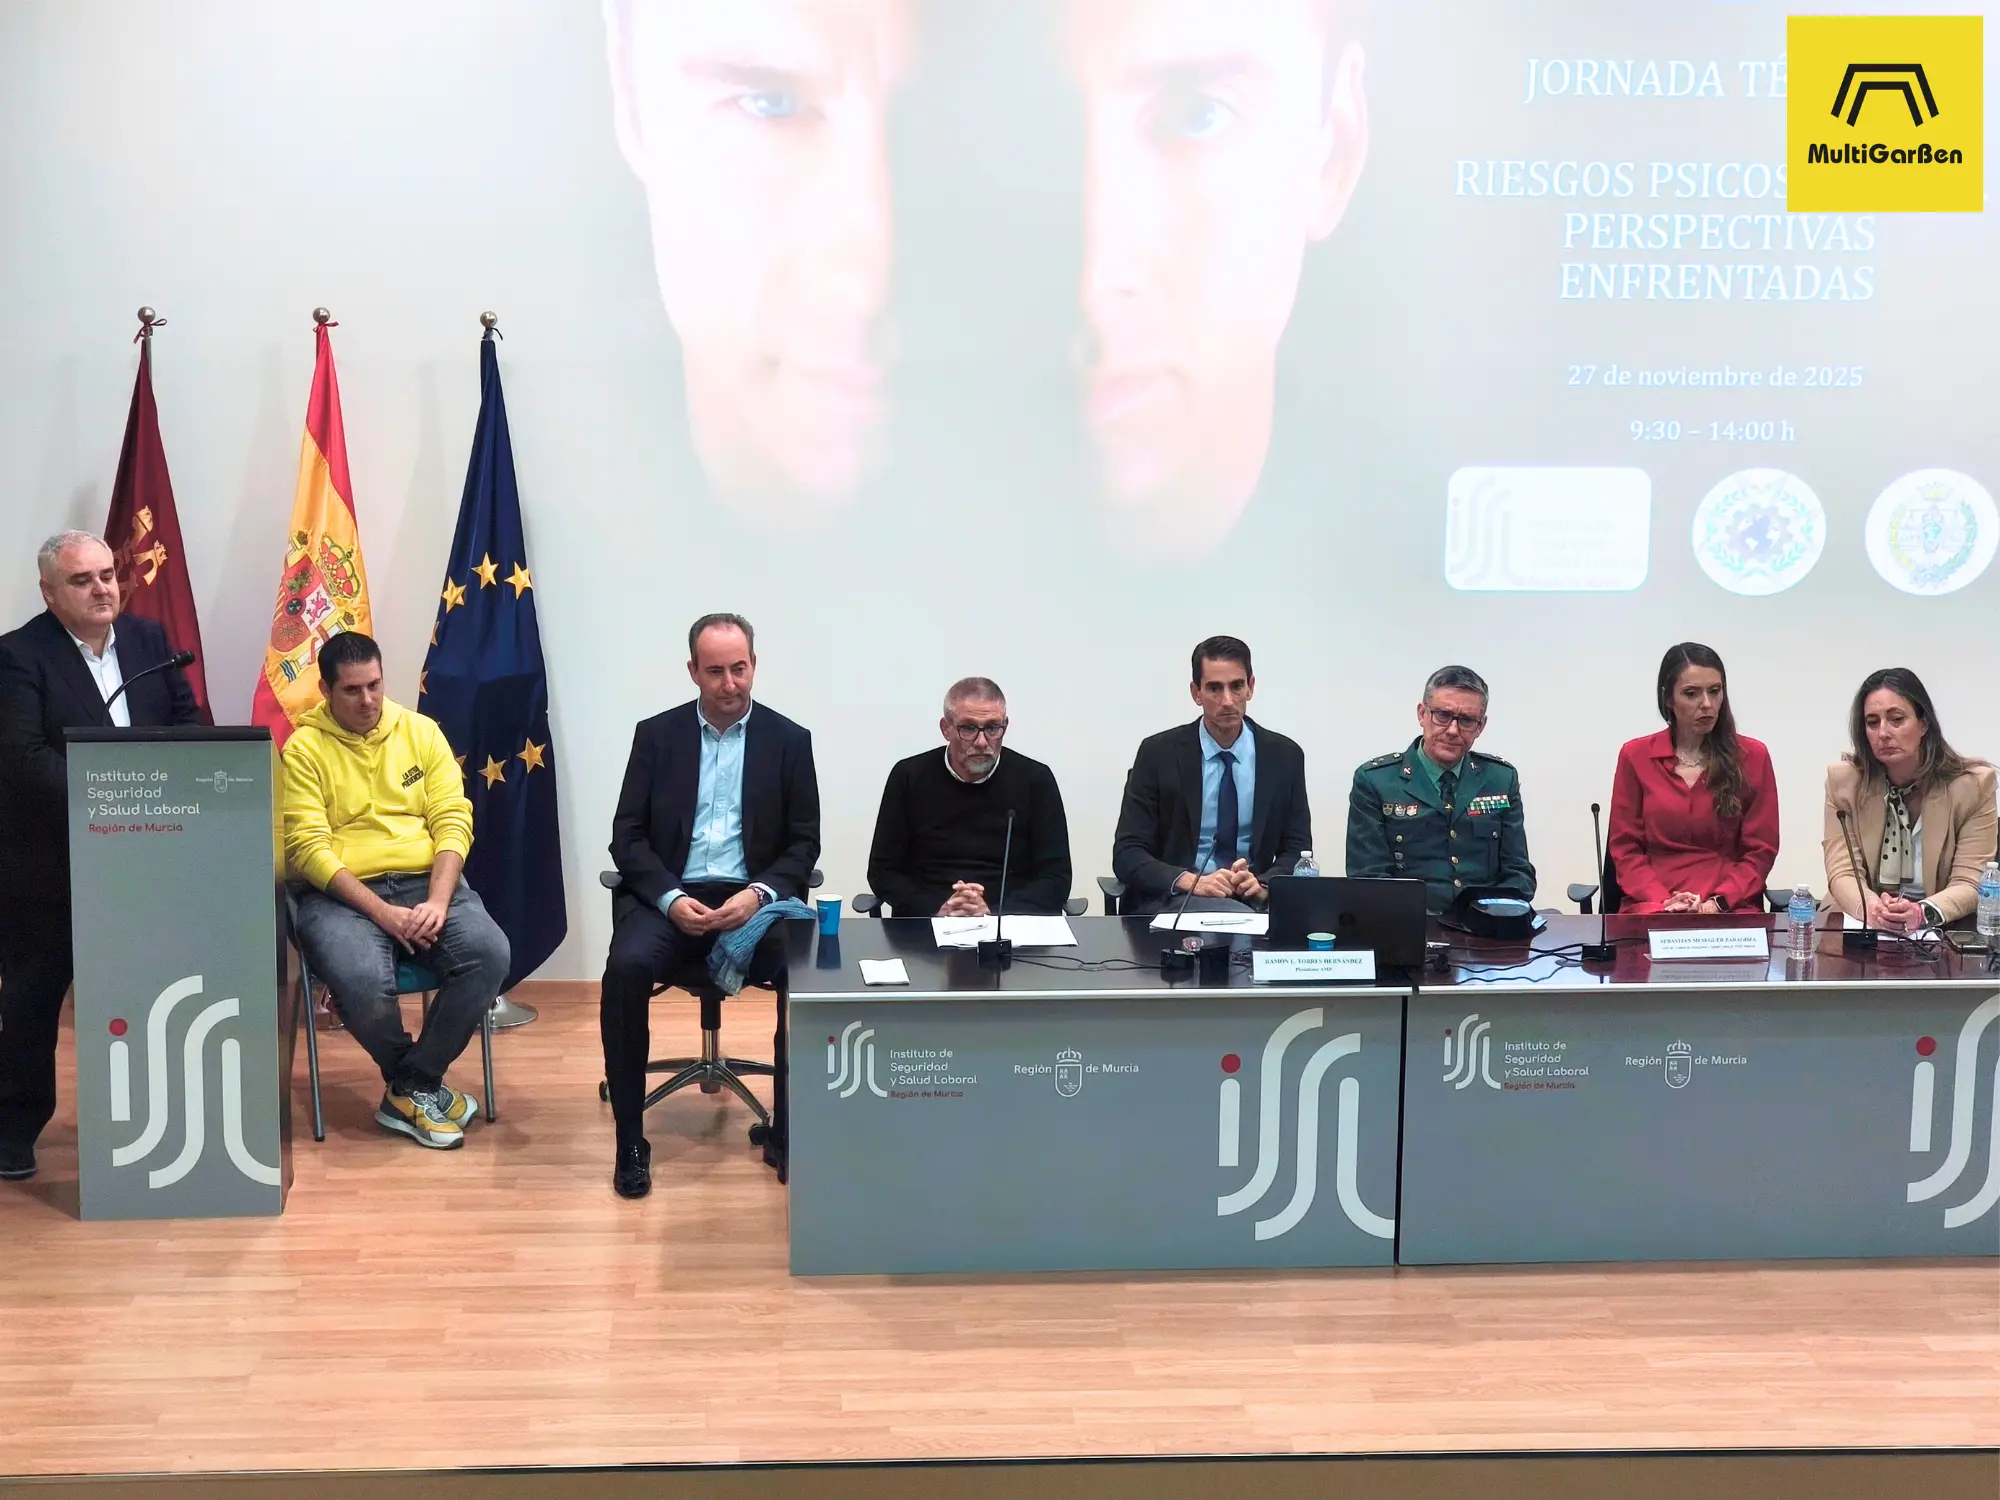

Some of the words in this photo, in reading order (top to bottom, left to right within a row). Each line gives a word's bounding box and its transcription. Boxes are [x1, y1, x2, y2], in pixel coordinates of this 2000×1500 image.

[1524, 58, 1726, 105] JORNADA
[1738, 50, 1787, 101] TÉ
[1453, 159, 1635, 199] RIESGOS
[1647, 161, 1787, 202] PSICOS
[1561, 209, 1875, 253] PERSPECTIVAS
[1559, 261, 1874, 303] ENFRENTADAS
[1567, 364, 1597, 387] 27
[1603, 363, 1632, 387] de
[1636, 364, 1763, 388] noviembre
[1768, 364, 1797, 388] de
[1803, 365, 1864, 389] 2025
[1630, 420, 1681, 442] 9:30
[1707, 420, 1776, 441] 14:00
[1780, 419, 1796, 442] h
[86, 770, 146, 782] Instituto
[149, 769, 168, 782] de
[87, 786, 162, 802] Seguridad
[87, 807, 96, 820] y
[99, 802, 140, 816] Salud
[143, 802, 201, 815] Laboral
[87, 823, 126, 835] Región
[127, 823, 143, 833] de
[144, 822, 183, 832] Murcia
[1504, 1041, 1550, 1051] Instituto
[1552, 1040, 1567, 1051] de
[890, 1049, 937, 1059] Instituto
[939, 1048, 953, 1058] de
[1504, 1053, 1562, 1066] Seguridad
[890, 1061, 948, 1074] Seguridad
[1625, 1055, 1662, 1068] Región
[1694, 1055, 1709, 1065] de
[1711, 1054, 1747, 1065] Murcia
[1014, 1064, 1052, 1076] Región
[1085, 1063, 1099, 1073] de
[1102, 1063, 1139, 1073] Murcia
[1504, 1069, 1512, 1079] y
[1512, 1066, 1544, 1077] Salud
[1545, 1066, 1589, 1077] Laboral
[889, 1077, 898, 1087] y
[898, 1075, 931, 1085] Salud
[934, 1074, 978, 1085] Laboral
[1503, 1081, 1532, 1092] Región
[1533, 1082, 1545, 1090] de
[1546, 1081, 1576, 1089] Murcia
[890, 1090, 920, 1100] Región
[920, 1090, 932, 1098] de
[933, 1090, 964, 1098] Murcia
